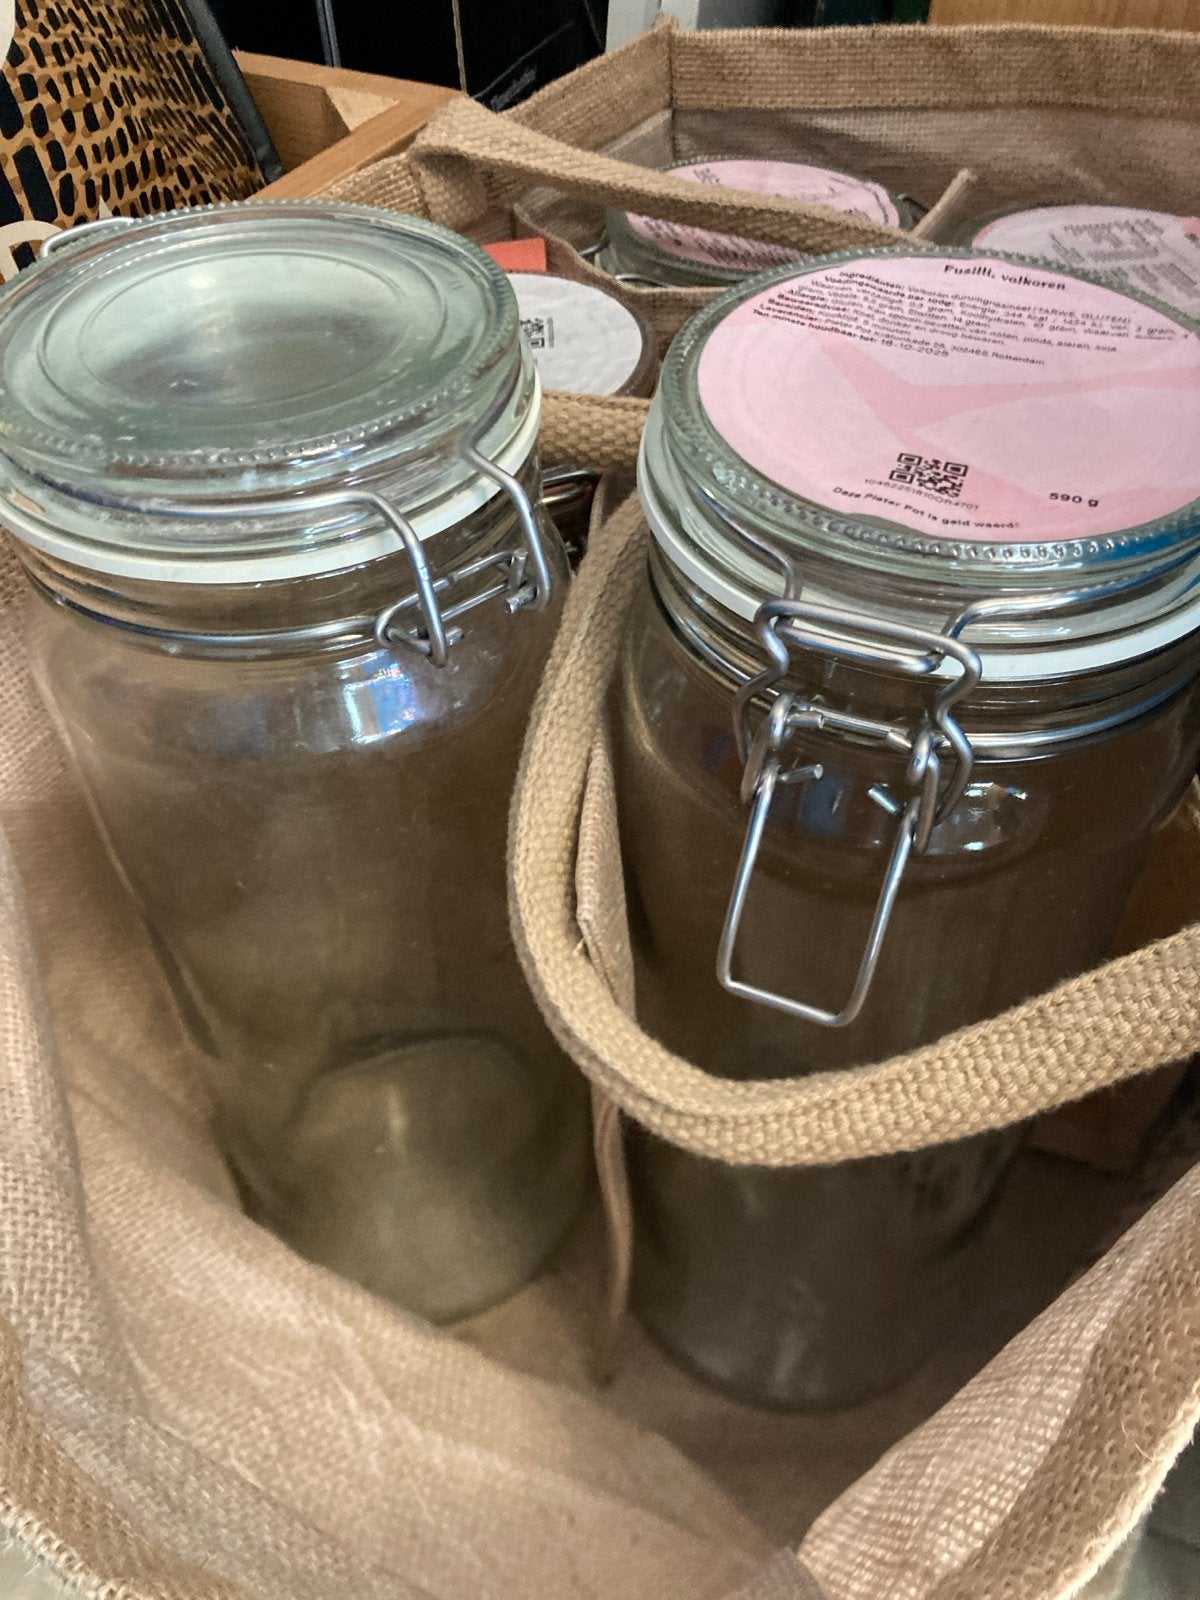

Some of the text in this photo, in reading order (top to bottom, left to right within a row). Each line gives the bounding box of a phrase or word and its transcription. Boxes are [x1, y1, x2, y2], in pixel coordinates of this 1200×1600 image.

[944, 264, 1066, 290] Fusilli, volkoren
[772, 315, 805, 326] minste
[808, 323, 856, 337] houdbaar
[855, 325, 871, 333] Pot
[992, 351, 1045, 365] Rotterdam
[832, 486, 861, 499] Deze
[864, 493, 901, 506] Pieter
[904, 504, 925, 517] Pot
[927, 511, 938, 521] is
[942, 518, 970, 527] geld
[1049, 492, 1099, 507] 590 g
